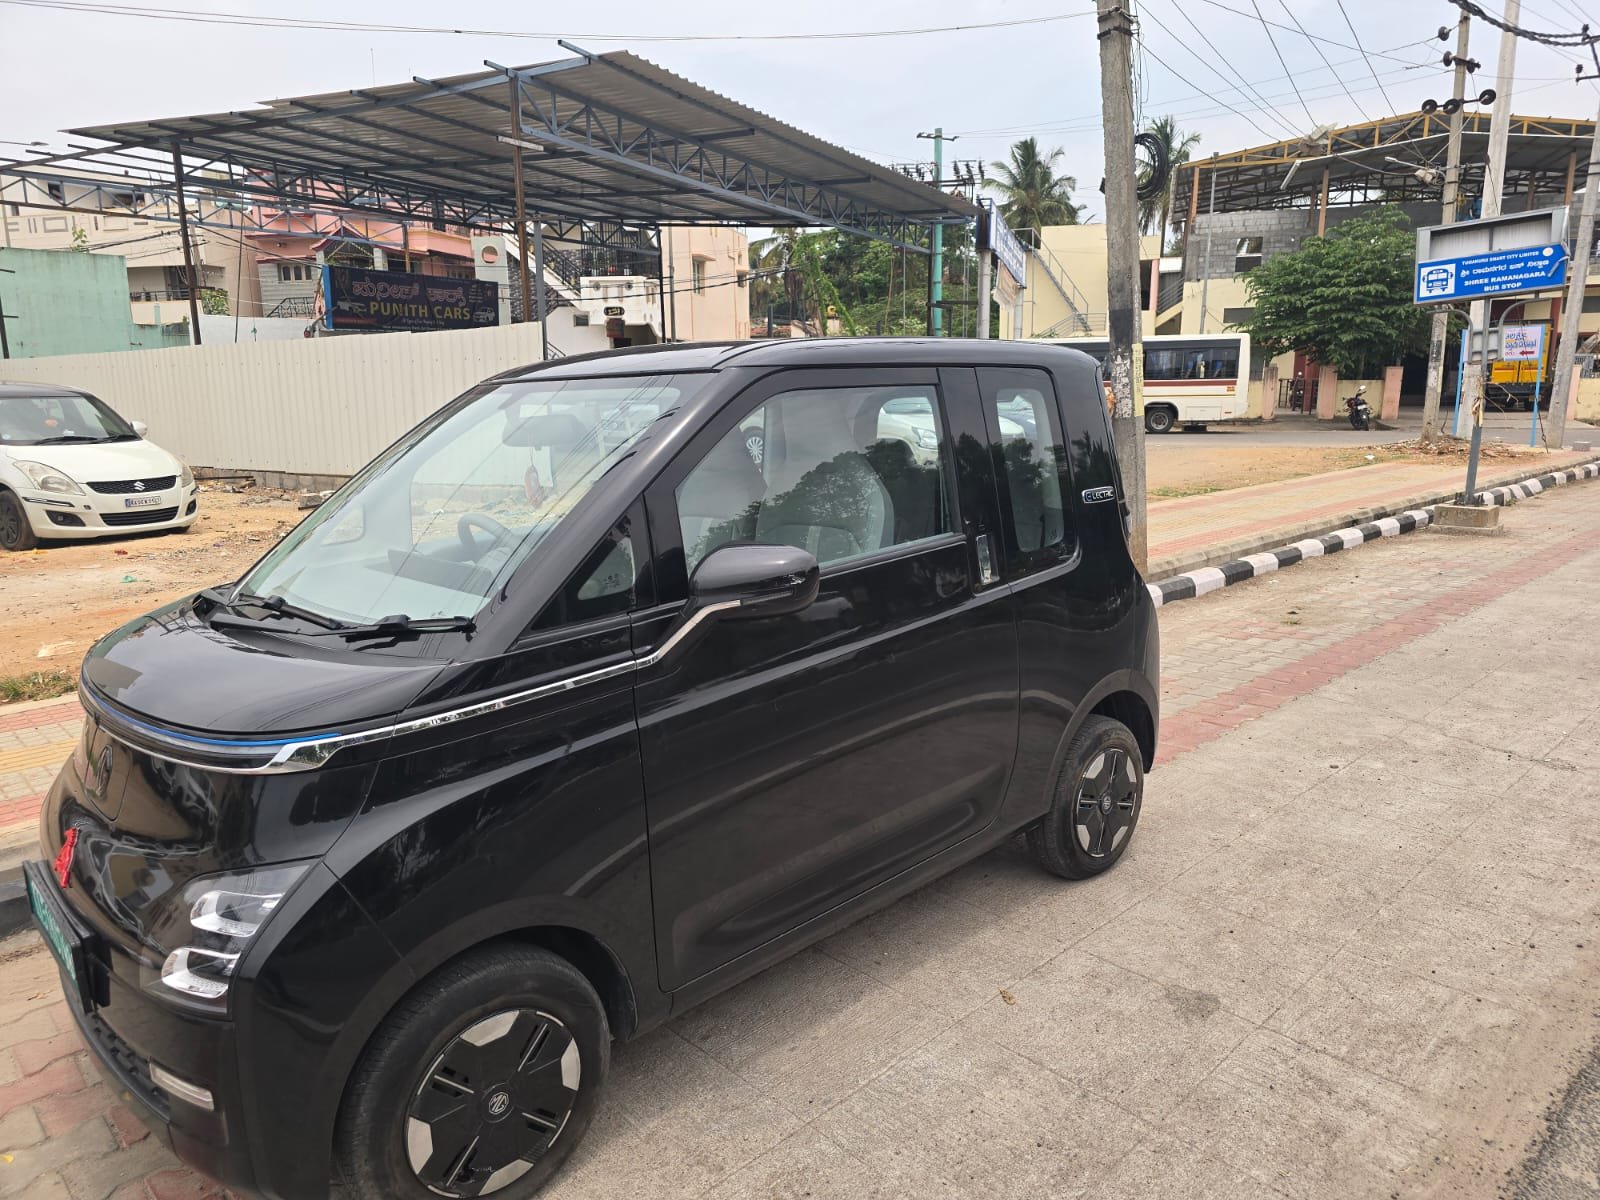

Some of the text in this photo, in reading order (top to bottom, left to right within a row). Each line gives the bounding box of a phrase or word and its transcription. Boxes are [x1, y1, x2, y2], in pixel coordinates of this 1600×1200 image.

[1472, 264, 1507, 275] ರಾಮನಗರ
[1464, 270, 1546, 287] SHREE RAMANAGARA
[1483, 284, 1500, 292] BUS
[369, 301, 471, 320] PUNITH CARS
